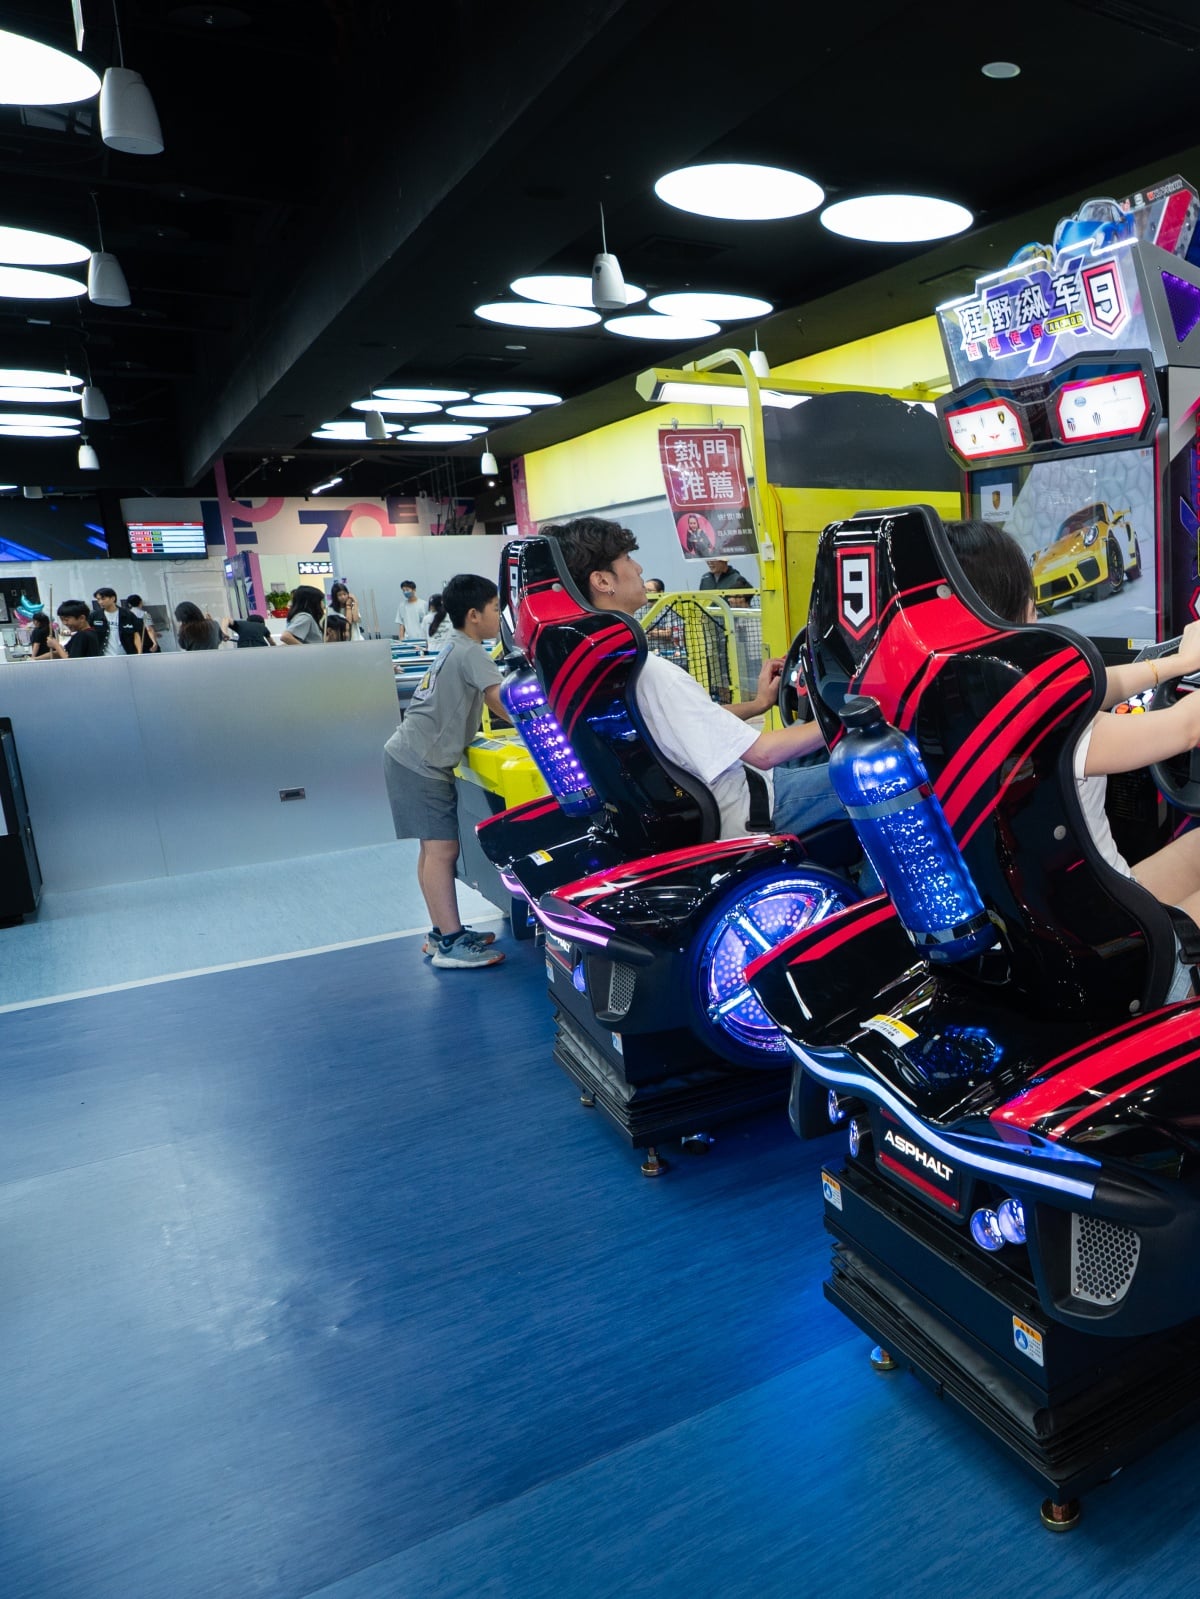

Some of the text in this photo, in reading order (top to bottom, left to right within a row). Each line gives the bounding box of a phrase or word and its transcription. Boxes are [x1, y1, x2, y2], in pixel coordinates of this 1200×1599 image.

[963, 273, 1080, 344] 狂野飙车
[1089, 272, 1122, 326] 9
[674, 439, 729, 469] 熱門
[680, 470, 734, 501] 推薦
[842, 558, 870, 627] 9
[884, 1130, 954, 1181] ASPHALT
